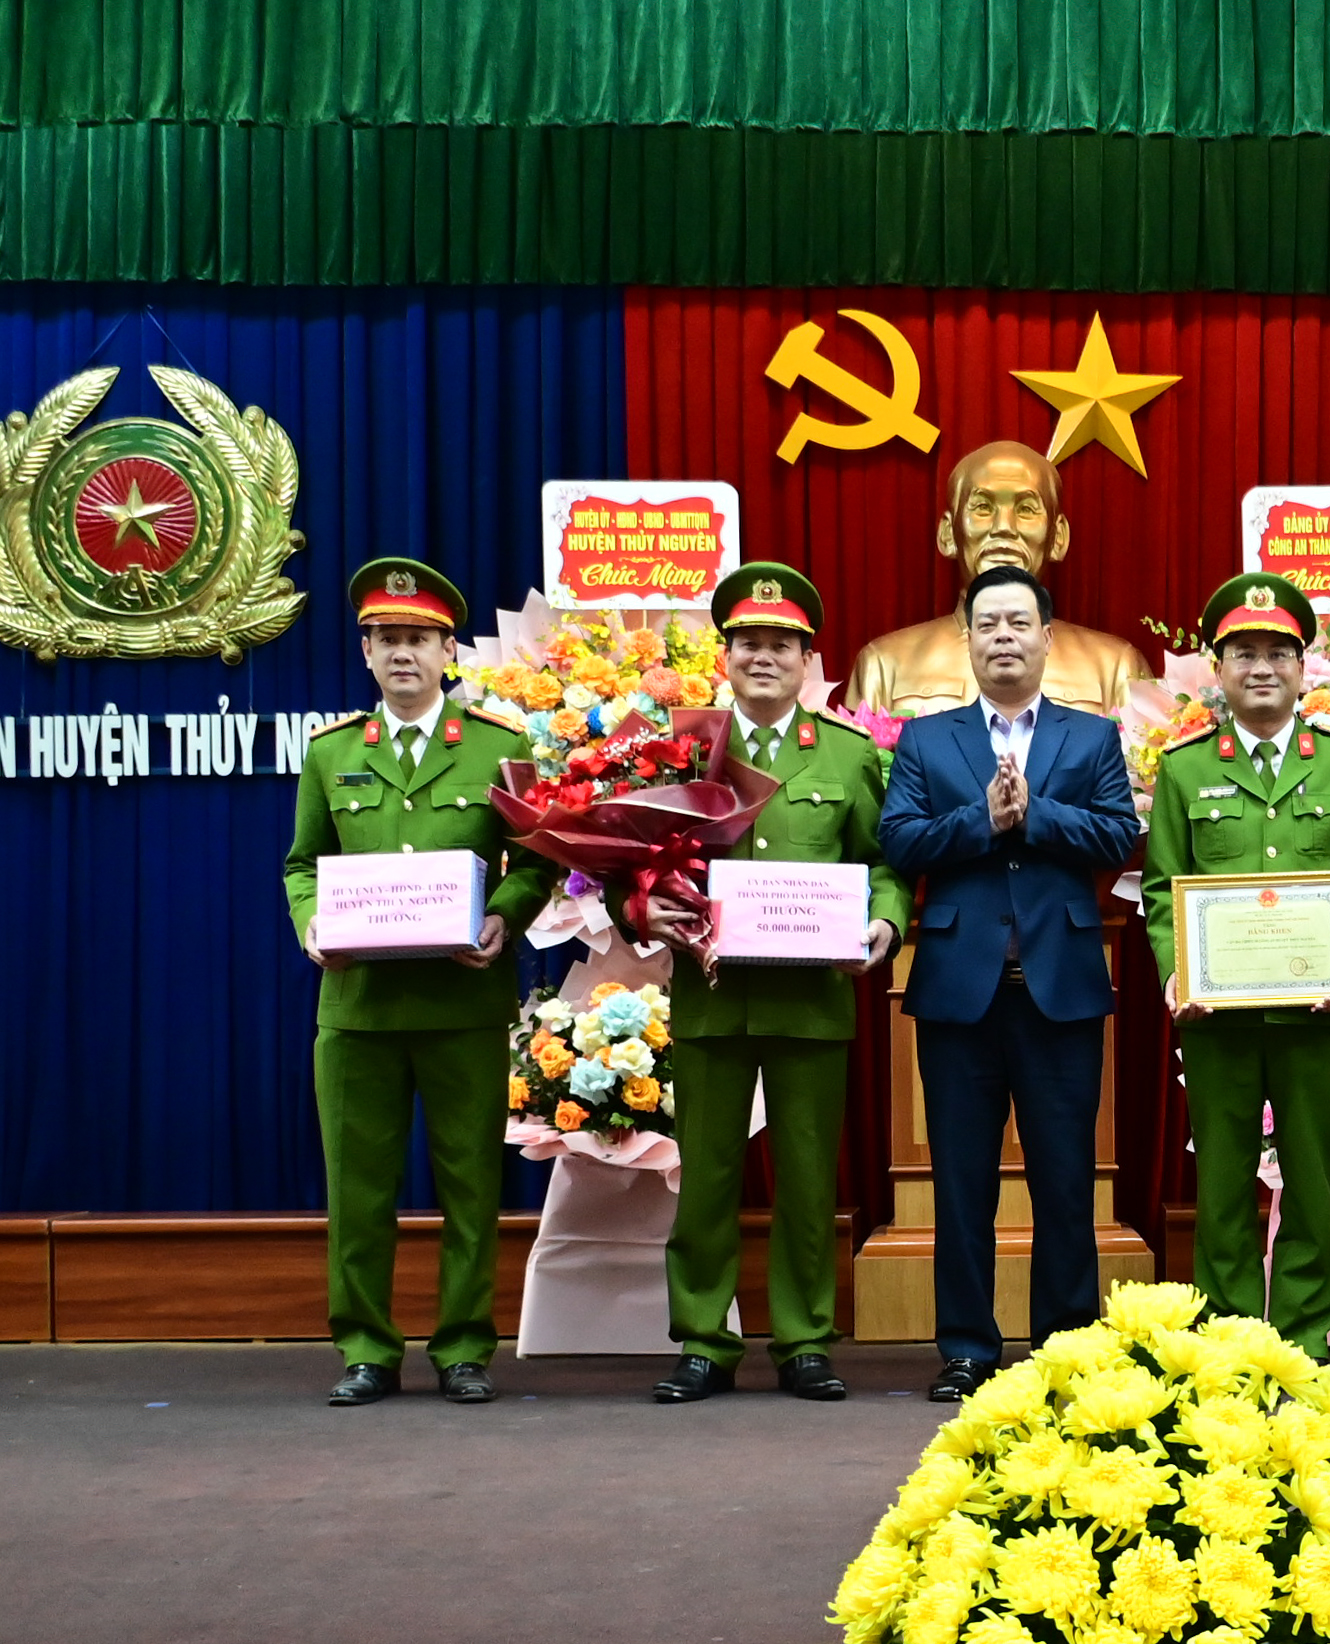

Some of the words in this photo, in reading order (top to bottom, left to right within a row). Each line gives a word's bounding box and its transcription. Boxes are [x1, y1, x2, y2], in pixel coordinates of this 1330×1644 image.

[1283, 511, 1313, 534] ĐẢNG
[568, 530, 616, 555] HUYỆN
[619, 529, 656, 552] THỦY
[659, 531, 717, 552] NGUYÊN
[1294, 538, 1308, 556] AN
[579, 562, 637, 587] Chúc
[633, 561, 707, 593] Mừng
[29, 702, 150, 787] HUYỆN
[165, 694, 258, 776] THỦY
